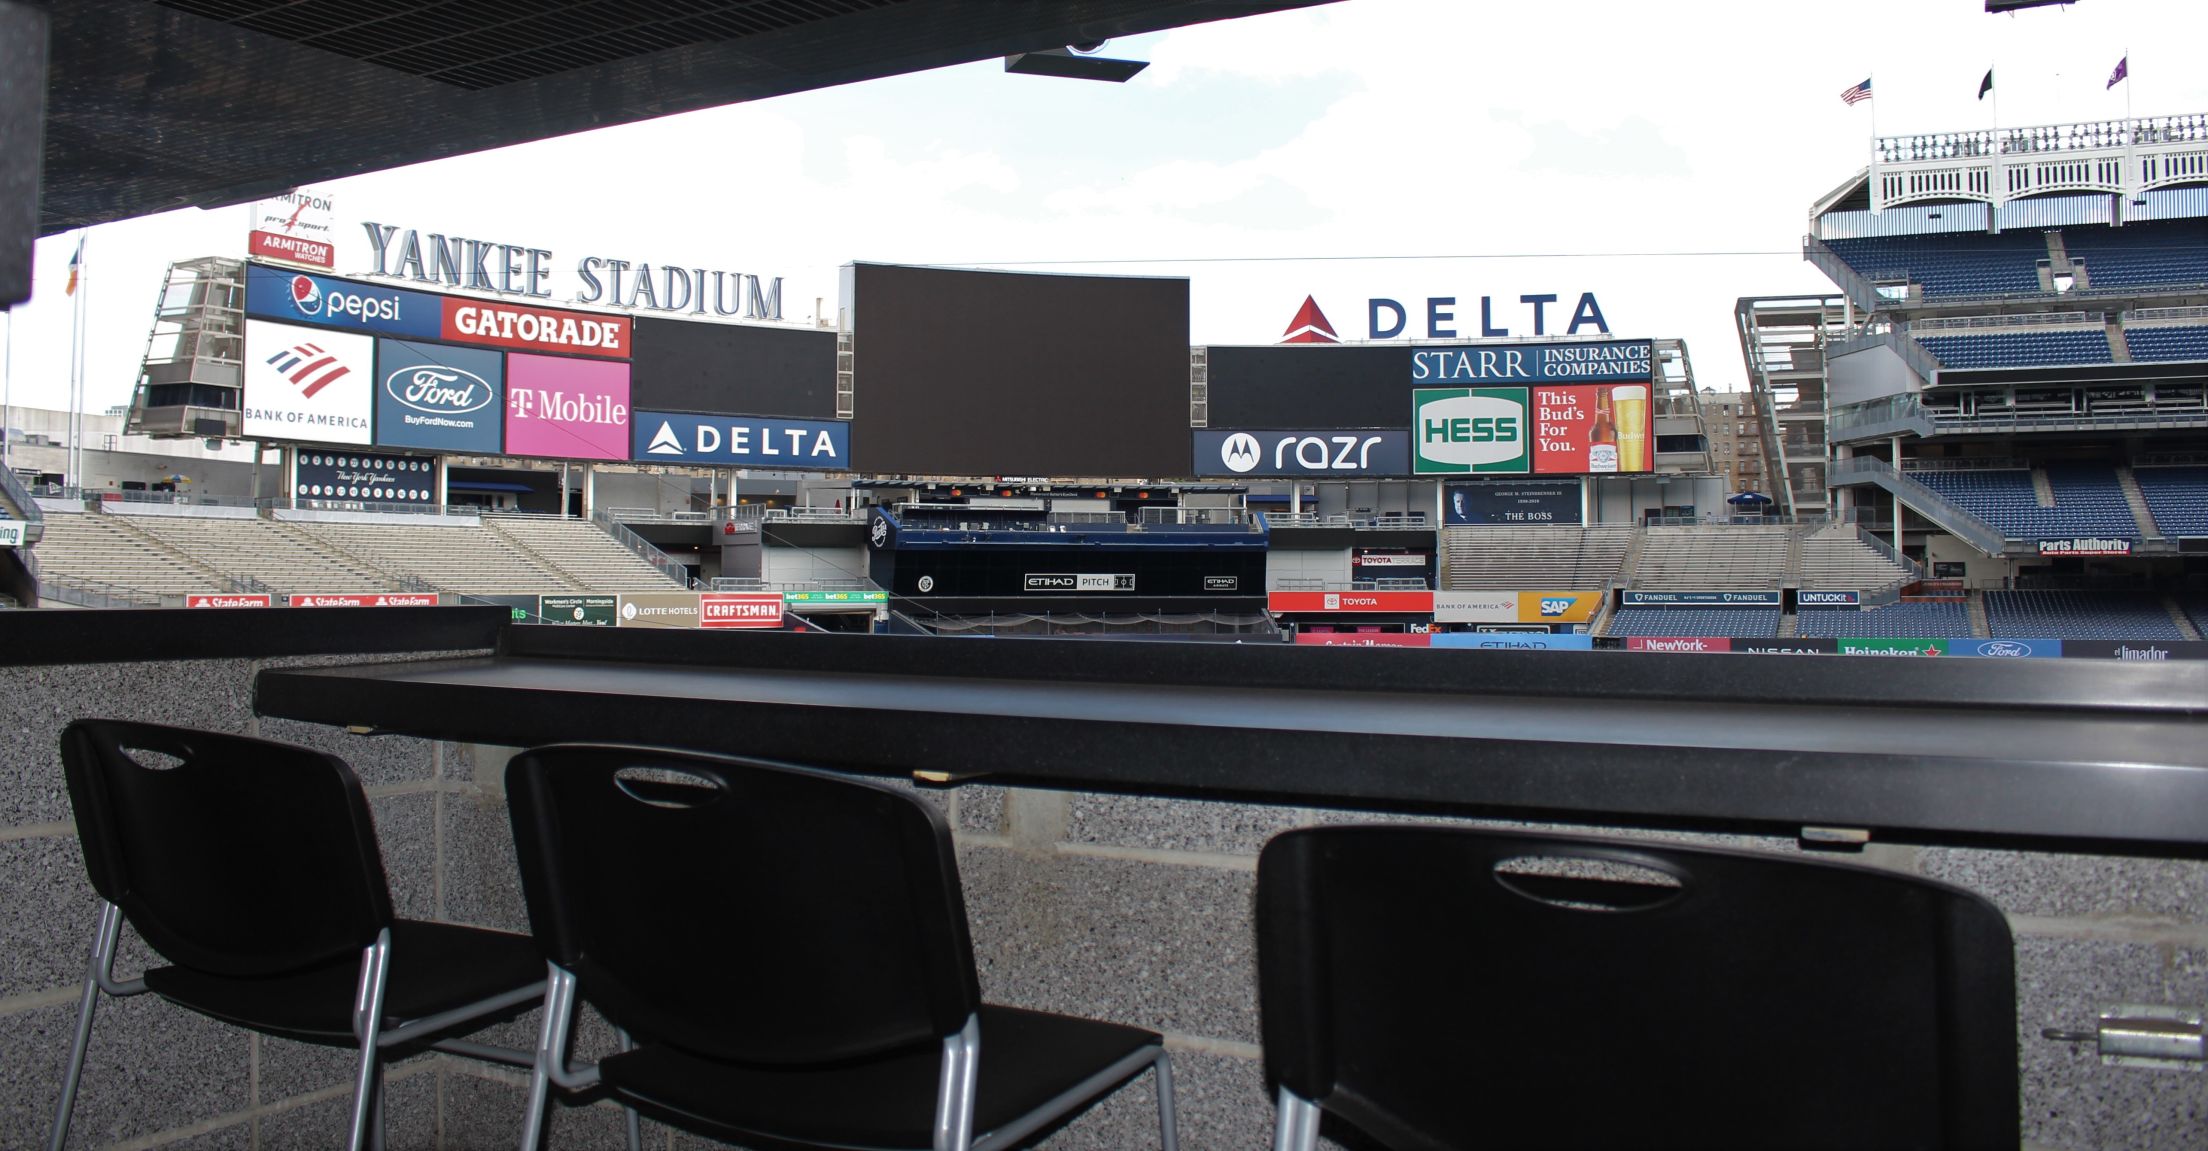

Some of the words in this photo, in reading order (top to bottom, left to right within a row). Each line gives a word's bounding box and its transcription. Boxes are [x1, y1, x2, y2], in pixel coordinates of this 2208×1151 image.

[271, 193, 331, 211] MITRON
[263, 235, 327, 257] ARMITRON
[295, 252, 326, 264] WATCHES
[362, 221, 552, 298] YANKEE
[577, 256, 785, 320] STADIUM
[327, 291, 401, 323] pepsi
[1368, 292, 1609, 338] DELTA
[454, 306, 620, 349] GATORADE
[1544, 346, 1650, 361] INSURANCE
[1412, 351, 1530, 379] STARR
[1544, 361, 1650, 377] COMPANIES
[405, 370, 472, 407] Ford
[1538, 391, 1576, 405] This
[538, 391, 627, 426] Mobile
[1539, 407, 1584, 420] Bud's
[245, 407, 282, 423] BANK
[287, 411, 304, 424] OF
[307, 415, 368, 429] AMERICA
[405, 414, 474, 429] BuyFordNow.com
[1425, 418, 1517, 443] HESS
[1539, 422, 1568, 436] For
[697, 423, 836, 458] DELTA
[1539, 438, 1576, 451] You.
[1275, 436, 1382, 469] razr
[351, 471, 368, 485] York
[1505, 512, 1525, 521] THE
[1528, 512, 1552, 521] BOSS
[2040, 540, 2071, 551] Parts
[2073, 537, 2130, 551] Authority
[1028, 578, 1074, 586] ETIHAD
[1083, 578, 1109, 586] PITCH
[639, 607, 667, 615] LOTTE
[669, 607, 698, 615] HOTELS
[706, 605, 776, 616] CRAFTSMAN
[1541, 600, 1568, 614] SAP
[1410, 623, 1441, 633] FedEx
[1480, 641, 1547, 649] ETIHAD
[1987, 643, 2020, 656] Ford
